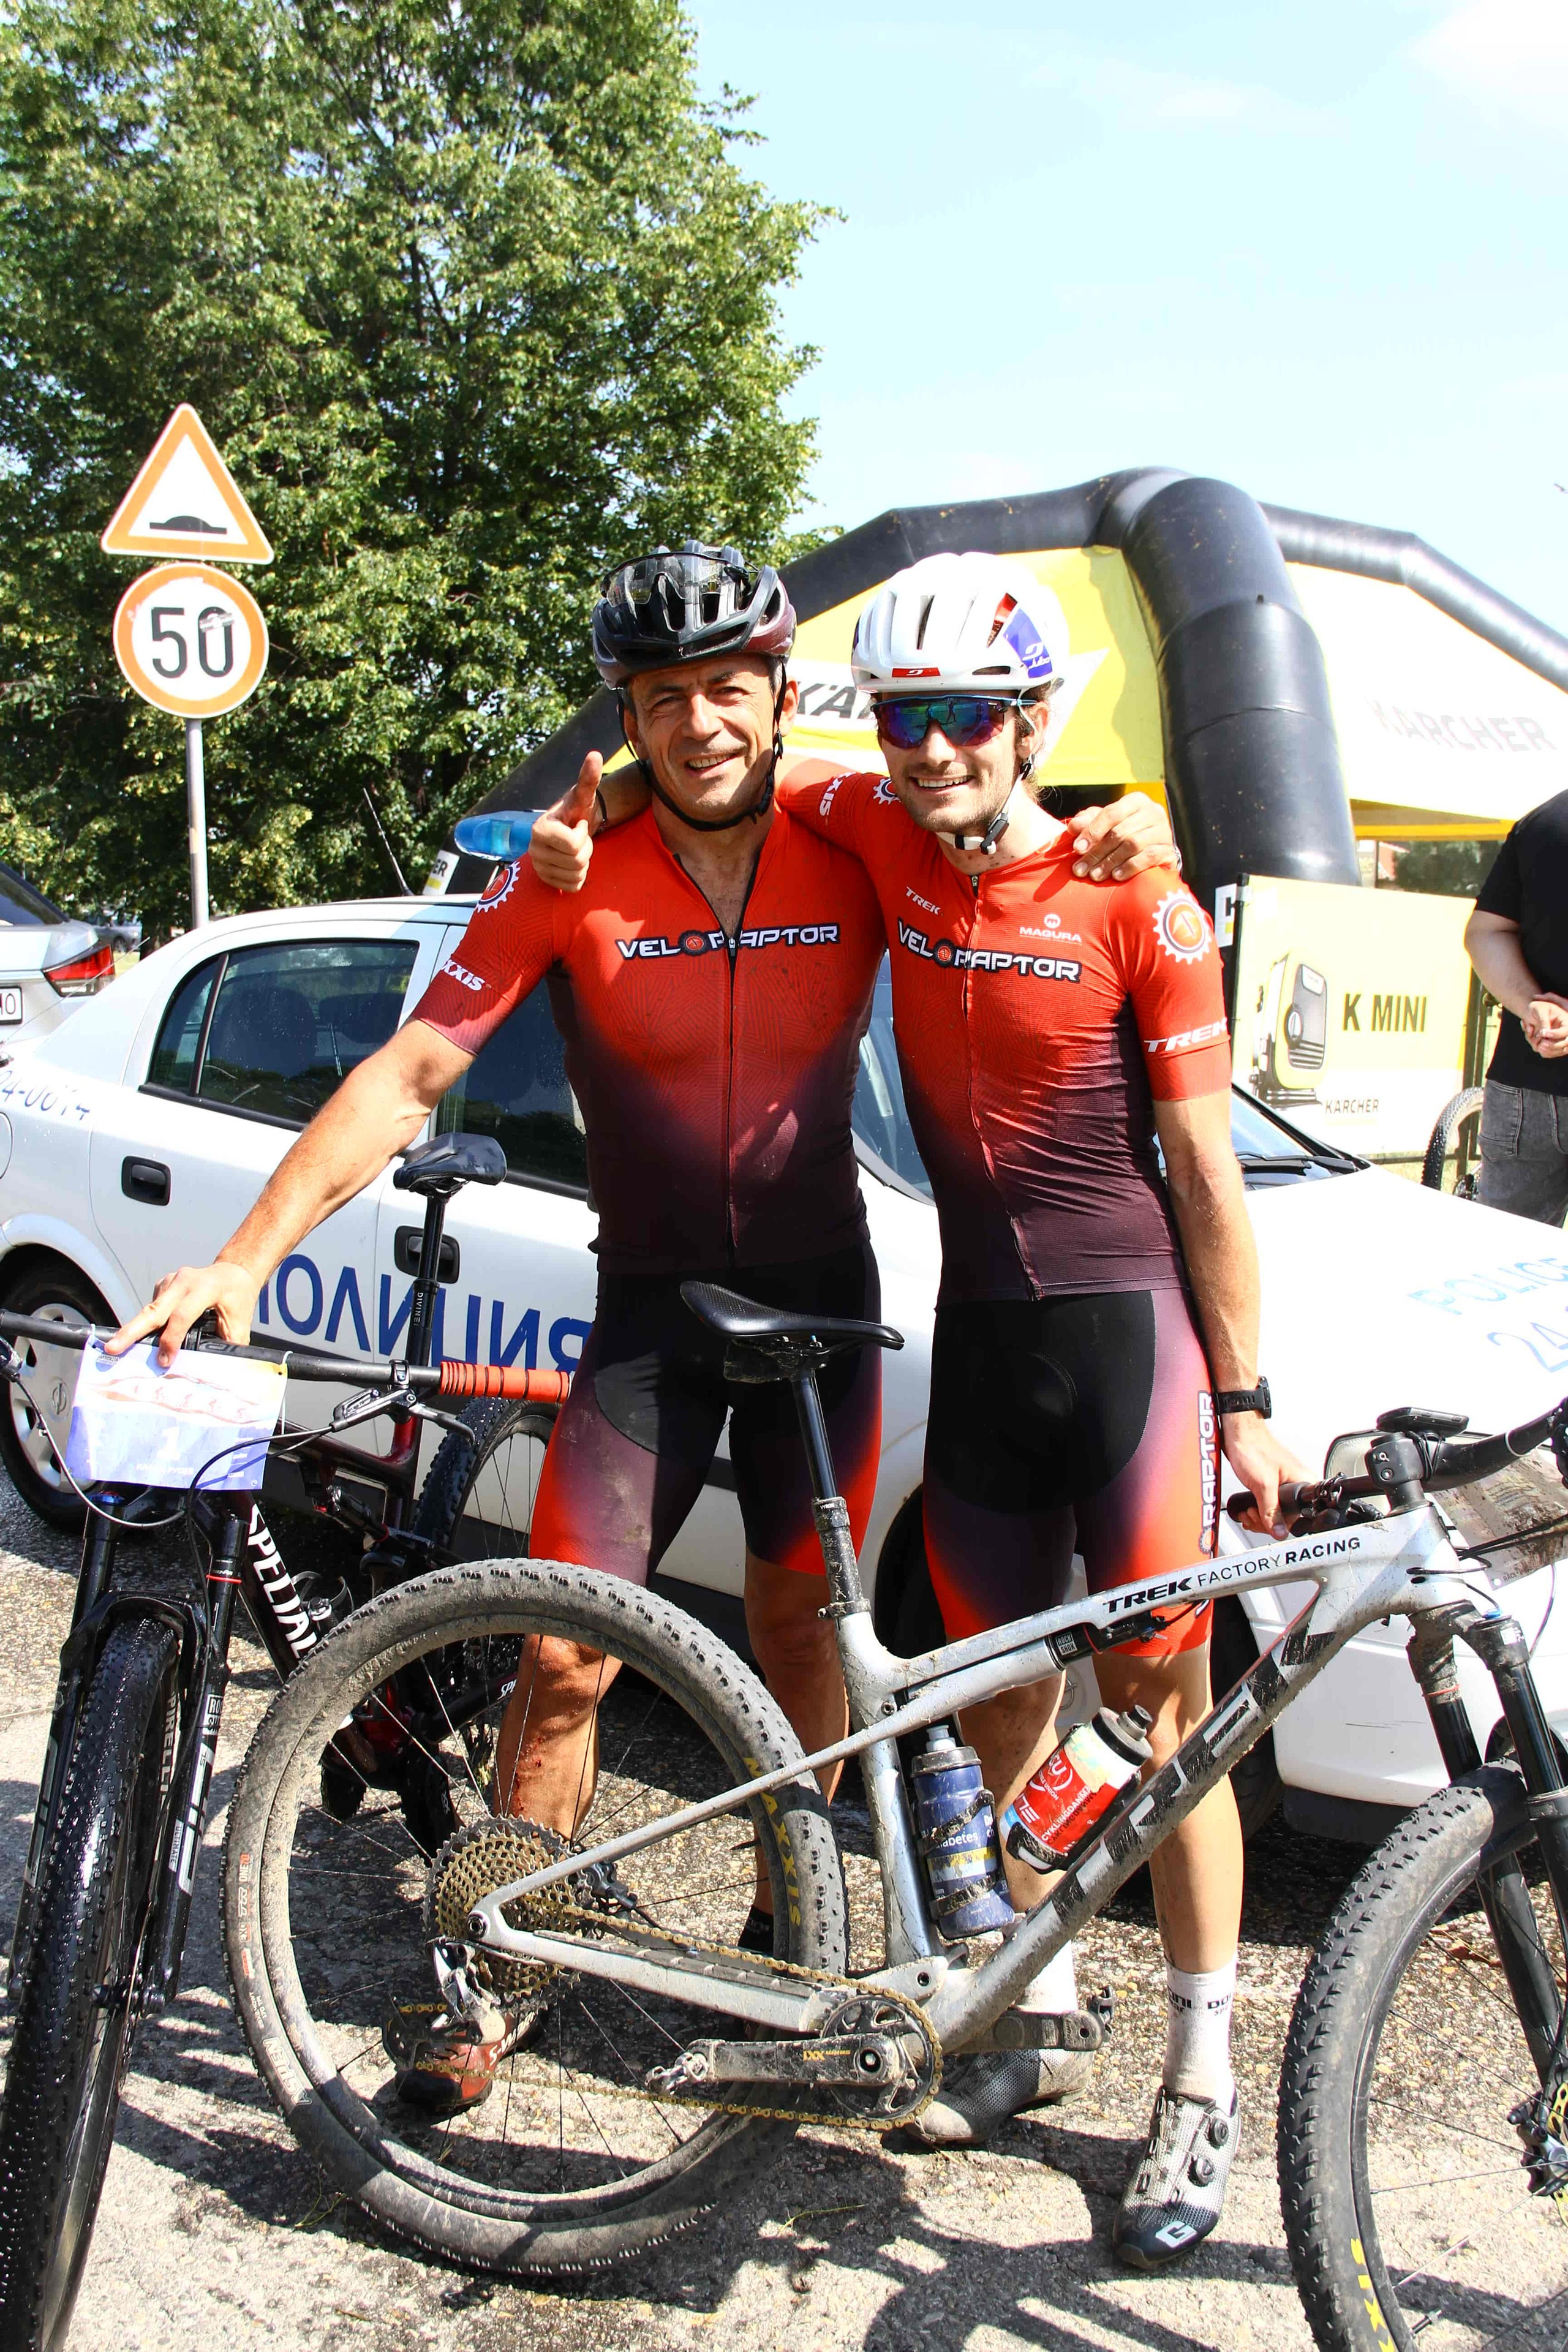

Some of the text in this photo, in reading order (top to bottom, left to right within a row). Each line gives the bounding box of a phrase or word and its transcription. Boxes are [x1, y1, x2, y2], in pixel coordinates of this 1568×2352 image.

[151, 606, 235, 678] 50
[906, 886, 942, 916] TREK
[1019, 927, 1082, 943] MAGURA
[1343, 993, 1427, 1032] K MINI
[1144, 1016, 1228, 1052] TREK
[1103, 1537, 1360, 1614] TREK FACTORY RACING
[160, 1692, 176, 1792] PIRELLI
[1044, 1782, 1060, 1801] UNION
[263, 2037, 313, 2106] ASPEN
